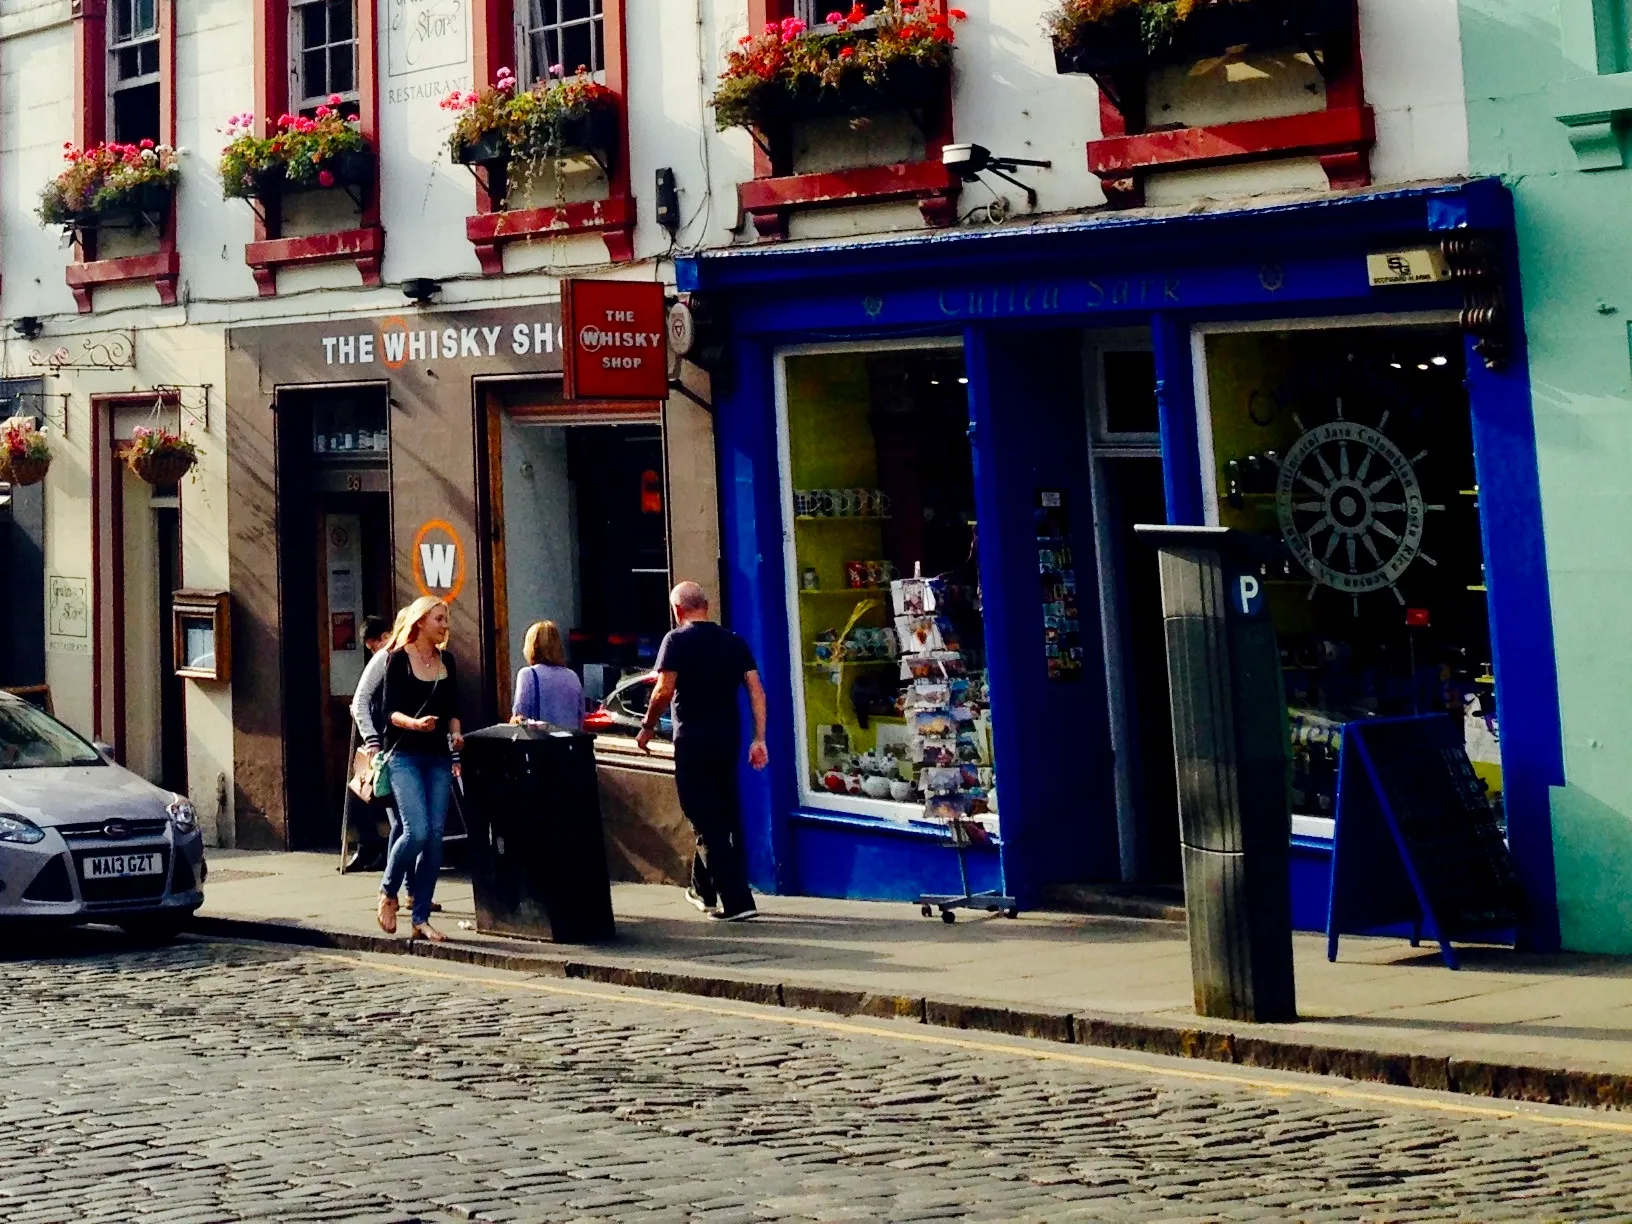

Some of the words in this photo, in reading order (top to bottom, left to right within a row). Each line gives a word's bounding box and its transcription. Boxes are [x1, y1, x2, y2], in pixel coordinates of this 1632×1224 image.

[417, 9, 458, 42] Store
[388, 76, 469, 105] RESTAURANT
[605, 310, 635, 323] THE
[322, 335, 374, 365] THE
[383, 326, 501, 362] WHISKY
[512, 323, 563, 355] SH
[582, 332, 661, 348] WHISKY
[602, 356, 642, 369] SHOP
[419, 543, 456, 588] W
[1239, 575, 1259, 614] P
[128, 854, 154, 872] GZT
